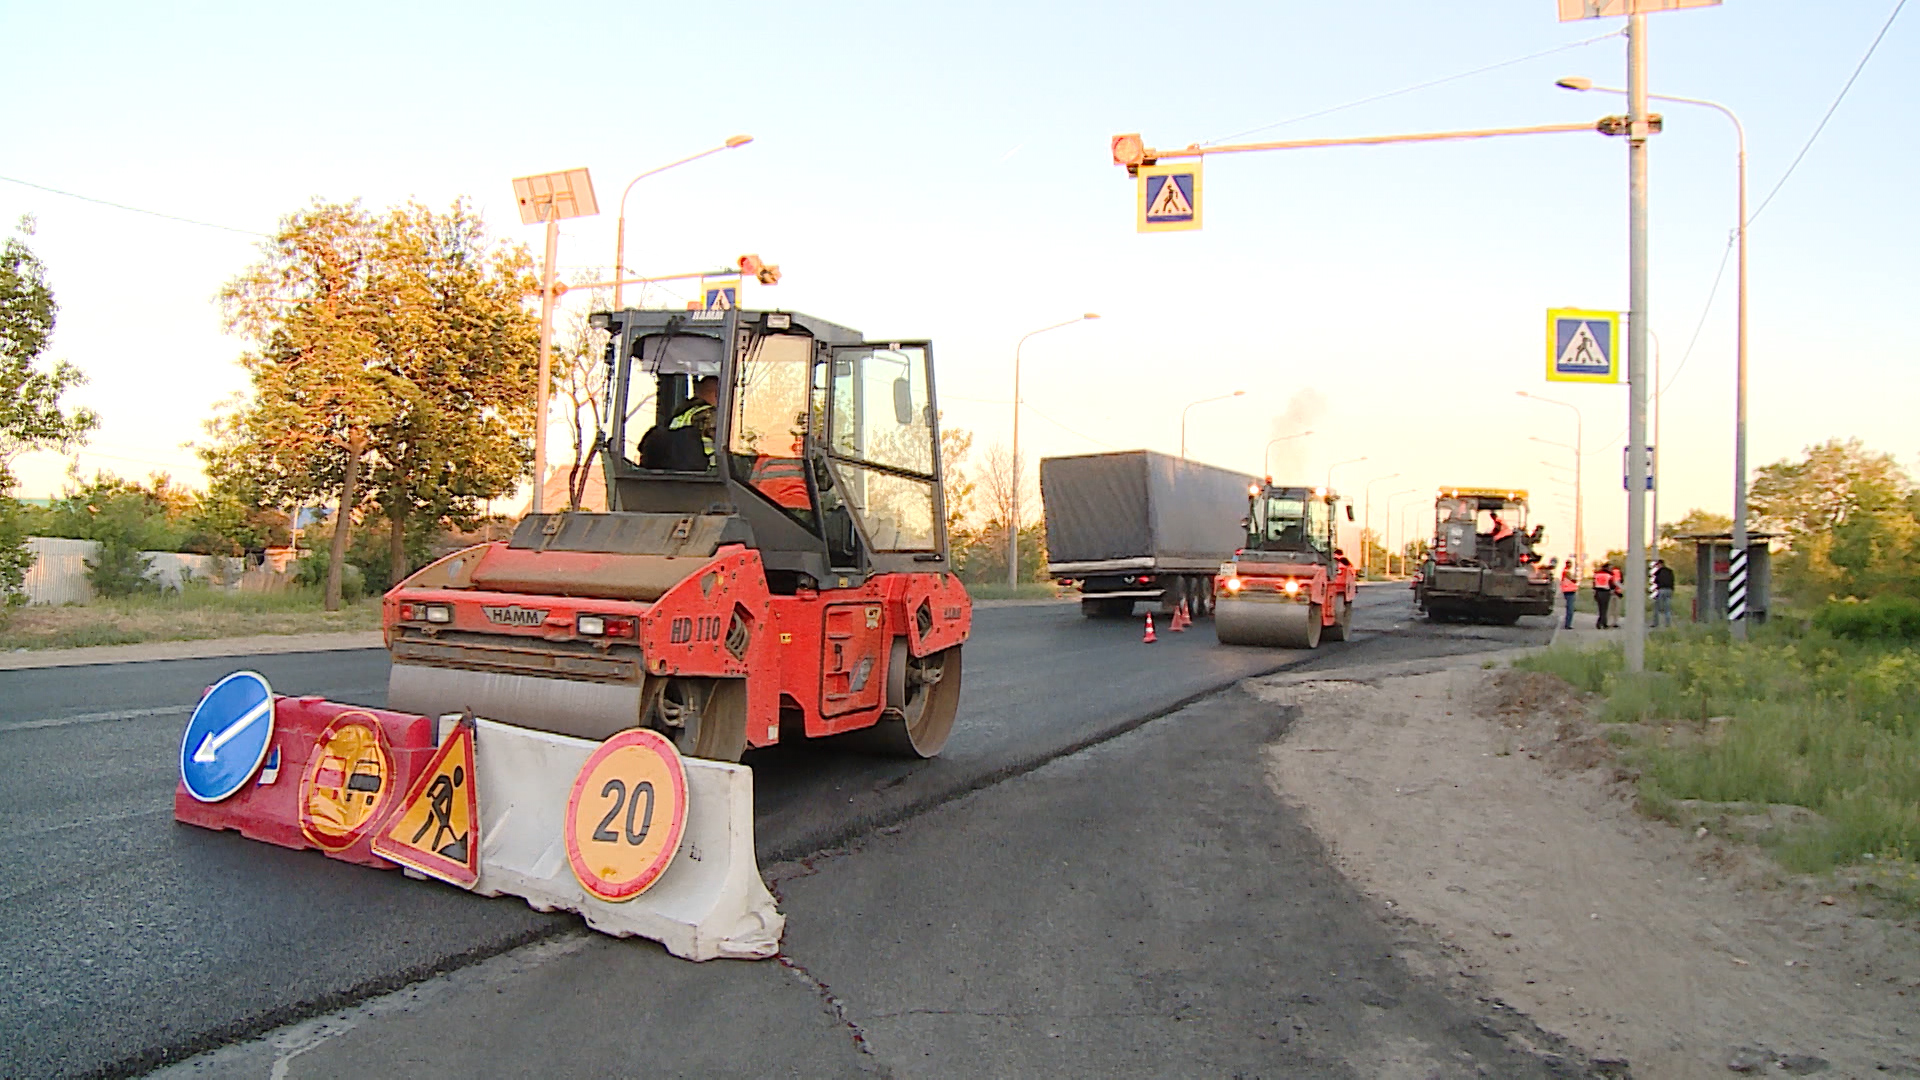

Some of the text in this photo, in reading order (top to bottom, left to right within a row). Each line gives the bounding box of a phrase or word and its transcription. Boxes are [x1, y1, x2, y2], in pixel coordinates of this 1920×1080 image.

[492, 608, 539, 624] HAMM
[670, 615, 721, 644] HD 110
[591, 778, 655, 847] 20
